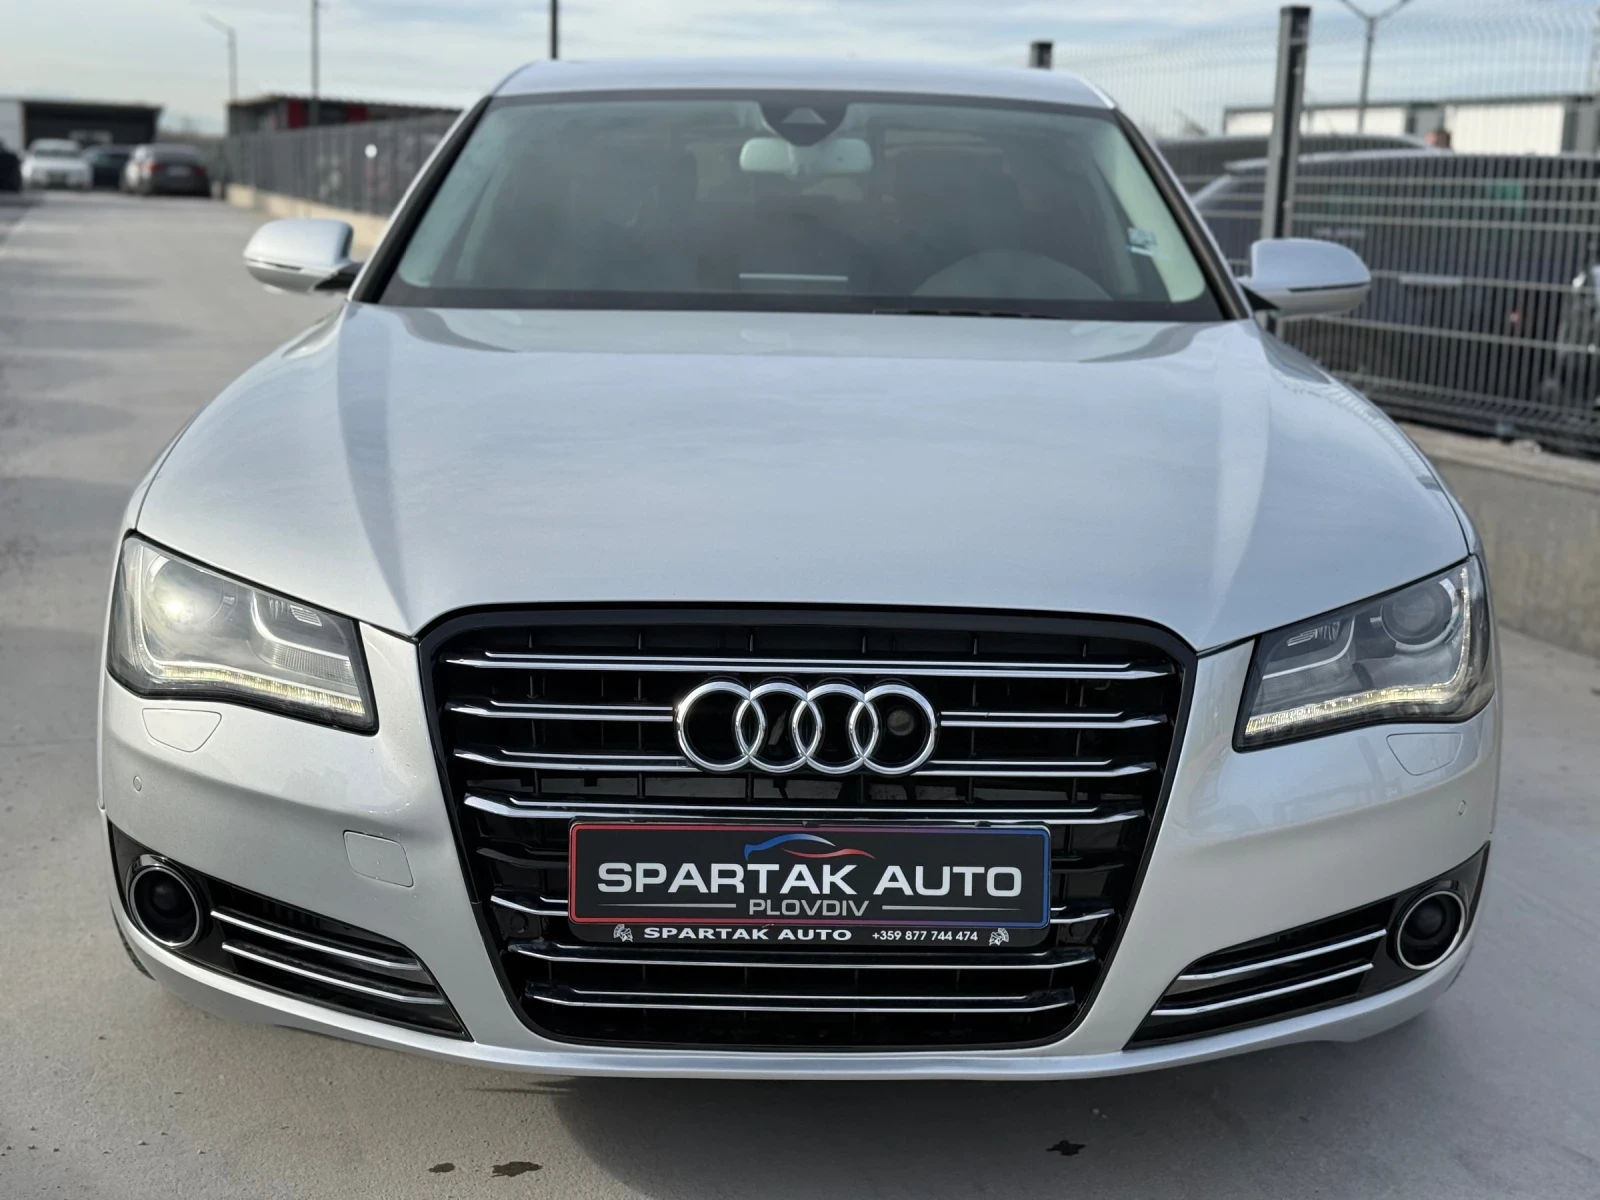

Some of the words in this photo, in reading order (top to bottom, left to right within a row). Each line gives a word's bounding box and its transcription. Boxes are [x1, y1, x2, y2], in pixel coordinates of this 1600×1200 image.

[597, 862, 858, 895] SPARTAK
[872, 865, 1022, 897] AUTO
[749, 899, 870, 917] PLOVDIV
[643, 927, 769, 940] SPARTAK
[777, 928, 852, 941] AUTO
[872, 930, 902, 941] +359
[905, 930, 926, 942] 877
[930, 930, 953, 942] 744
[955, 930, 979, 942] 474
